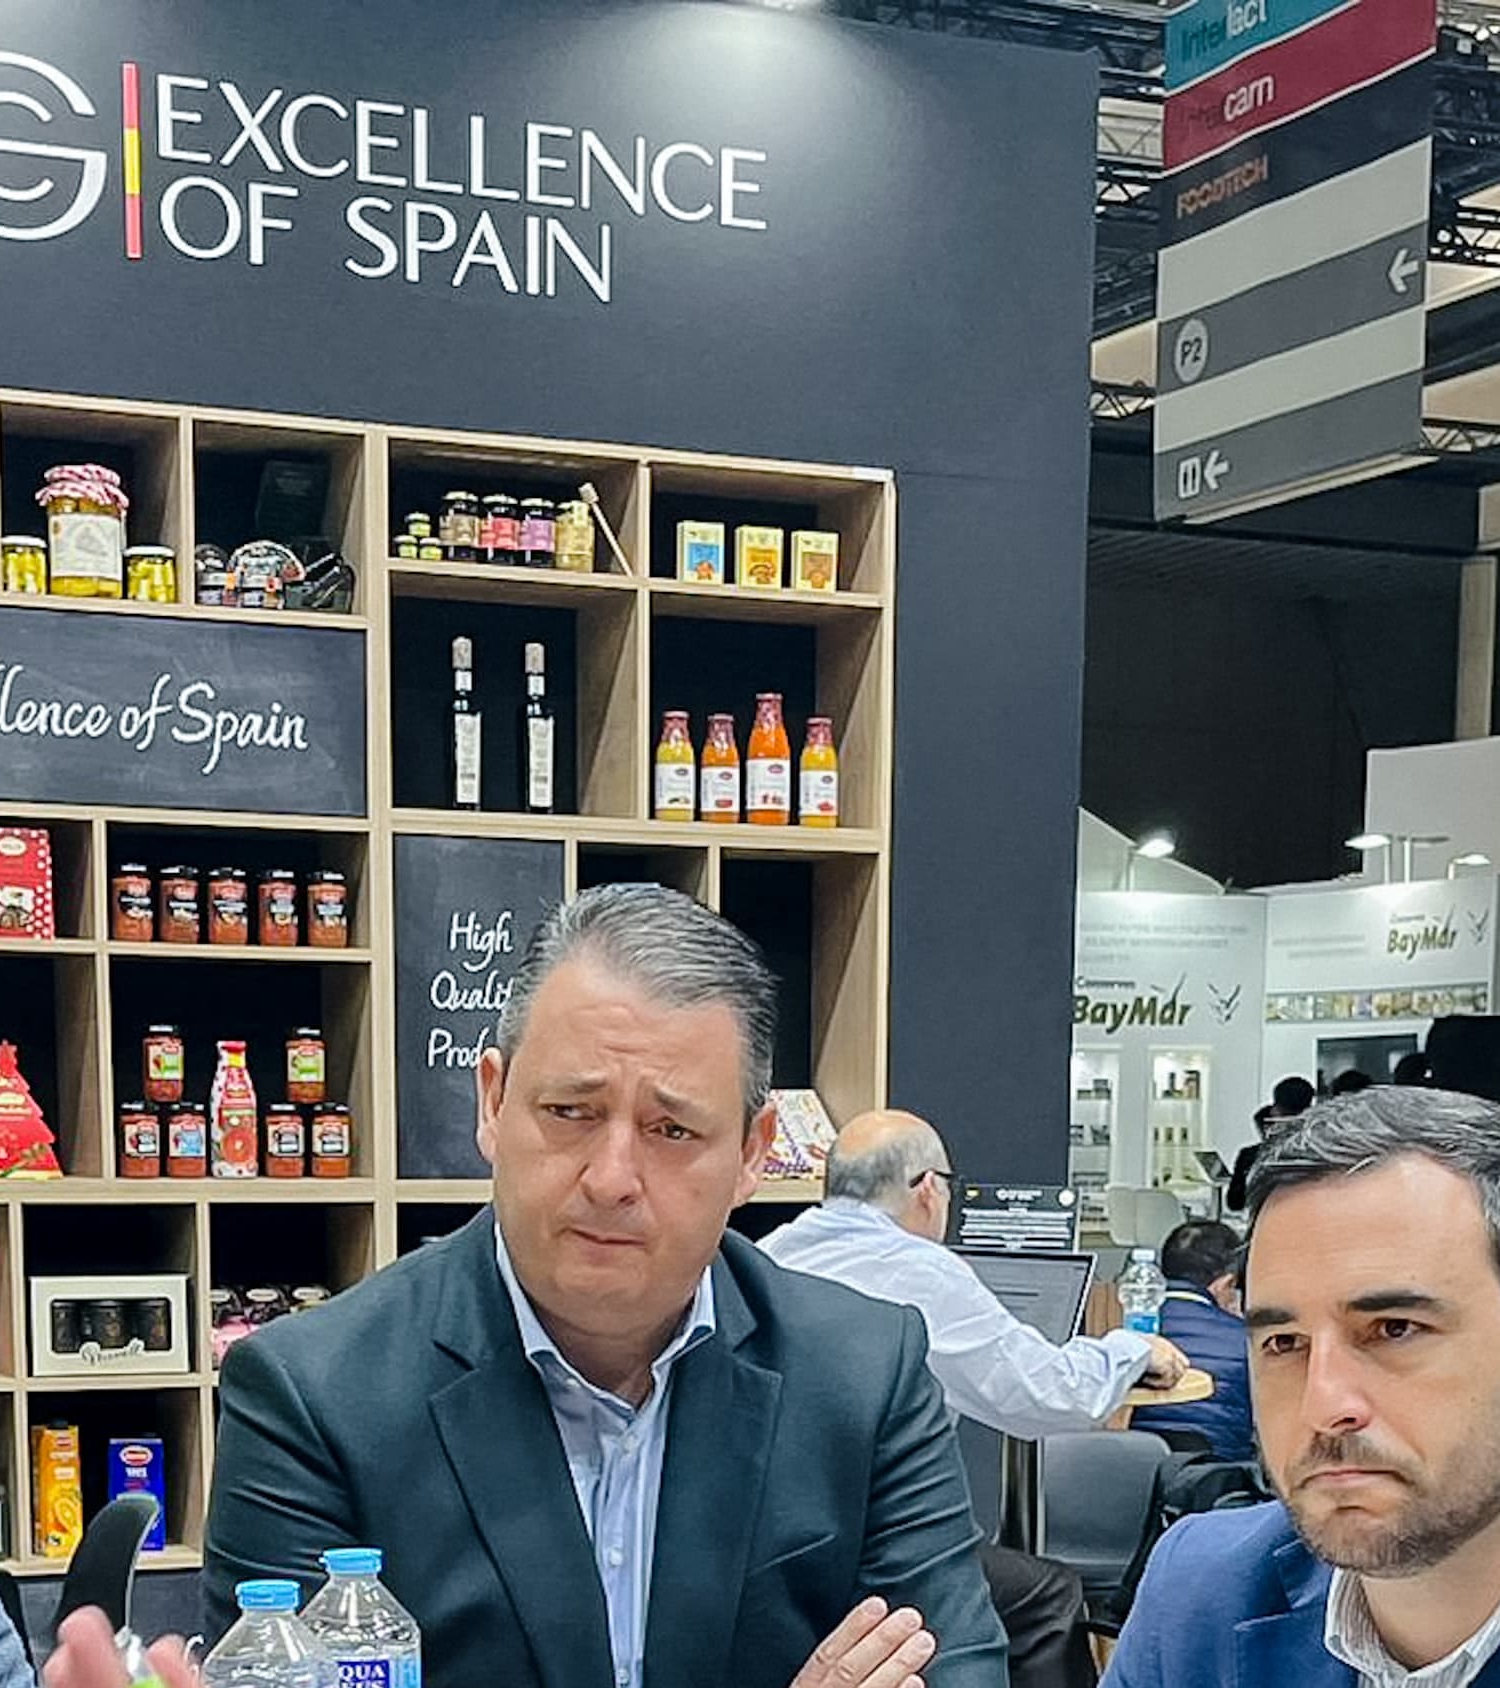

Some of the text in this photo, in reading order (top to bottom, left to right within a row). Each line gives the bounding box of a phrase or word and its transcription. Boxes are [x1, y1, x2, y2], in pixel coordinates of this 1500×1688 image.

[156, 73, 770, 230] EXCELLENCE
[158, 175, 613, 303] OF SPAIN
[1180, 336, 1203, 368] P2
[118, 673, 172, 752] of
[171, 681, 309, 774] Spain
[450, 911, 513, 972] High
[430, 969, 515, 1012] Qualit
[427, 1027, 490, 1069] Prod
[338, 1664, 386, 1679] QUA
